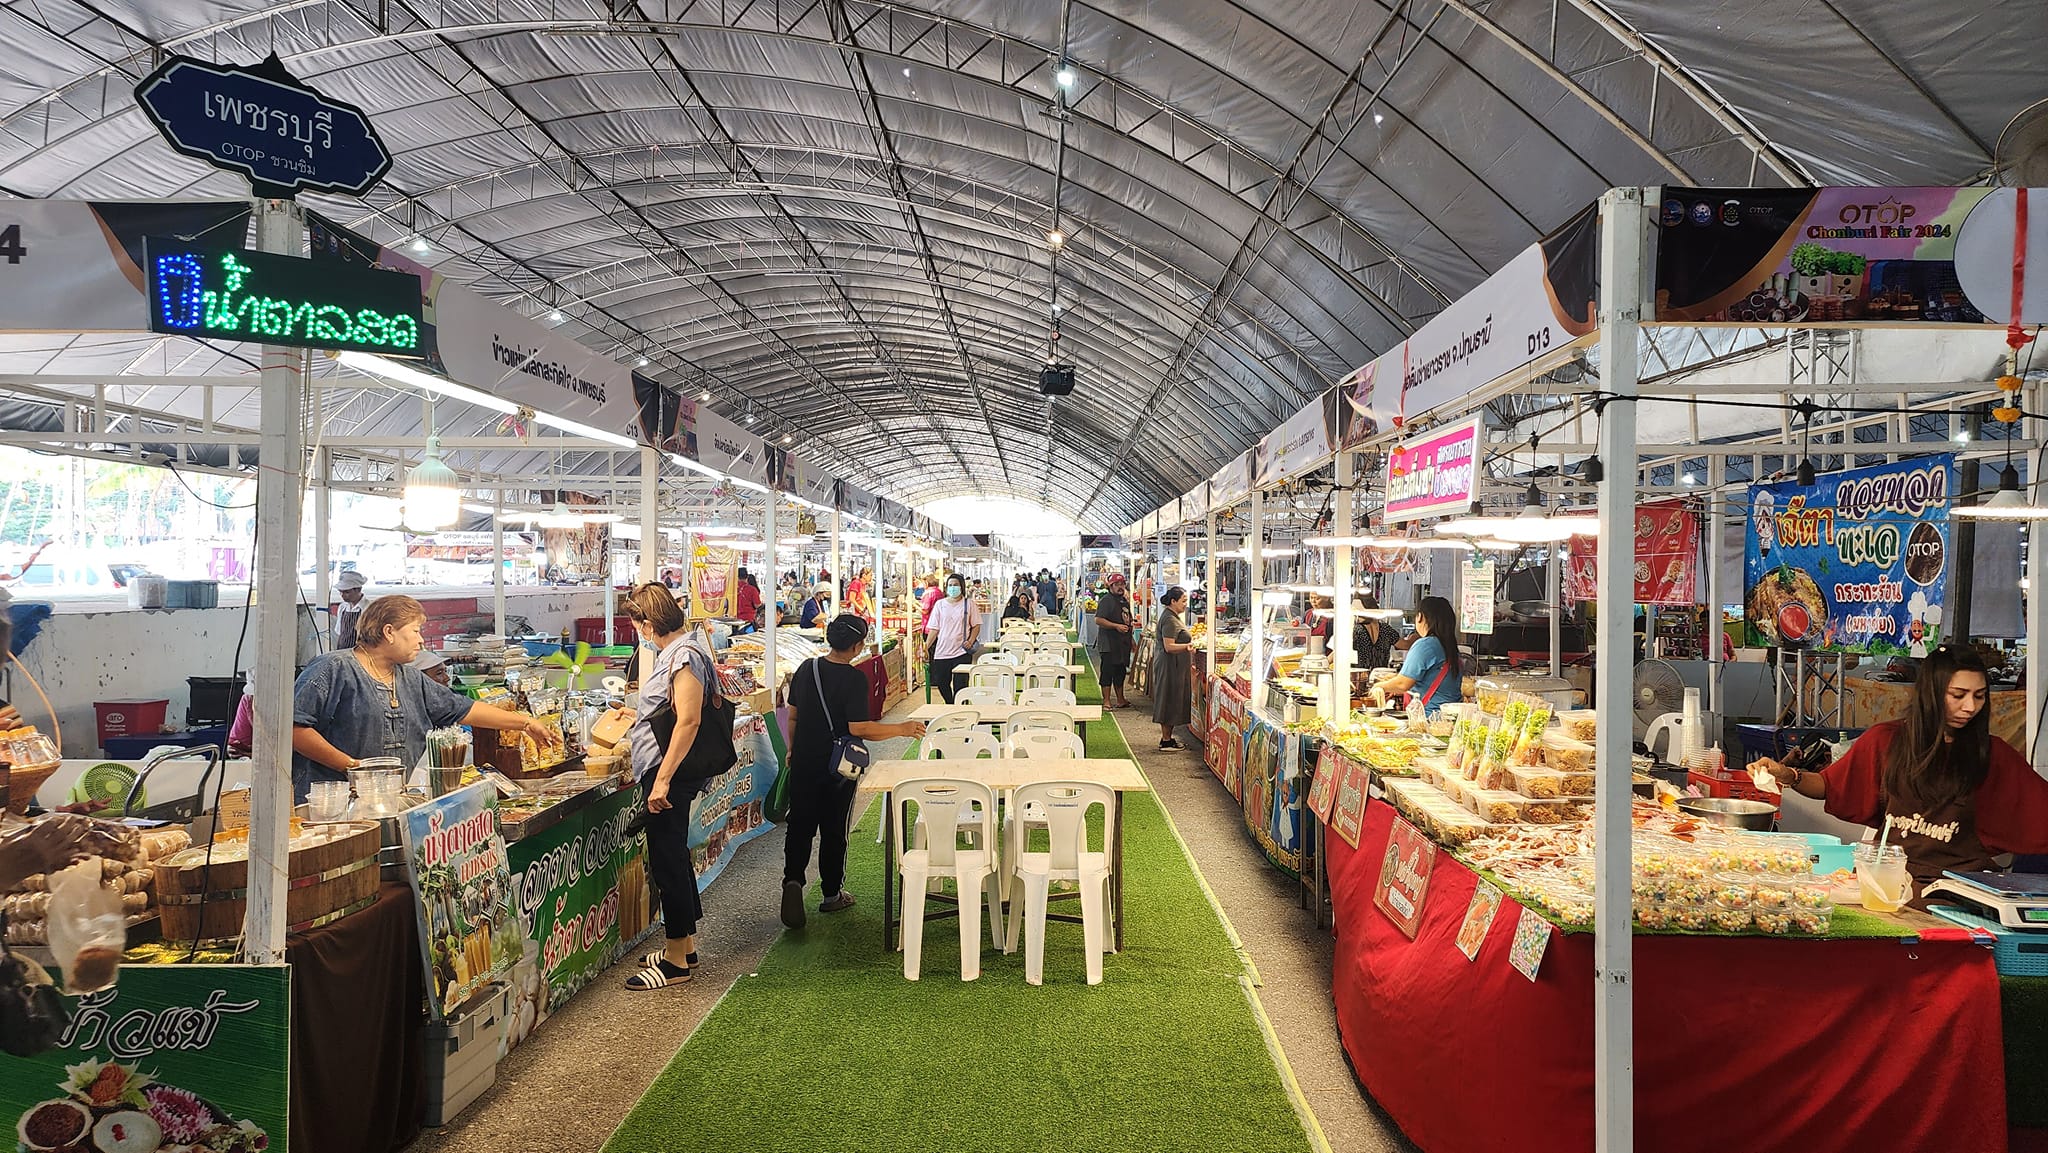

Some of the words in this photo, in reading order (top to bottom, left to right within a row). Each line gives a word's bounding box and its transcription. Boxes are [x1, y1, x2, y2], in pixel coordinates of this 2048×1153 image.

[204, 90, 334, 158] เพชรบุรี
[221, 142, 265, 162] OTOP
[270, 155, 316, 176] ชวนชิม
[1749, 206, 1773, 214] OTOP
[1839, 203, 1916, 224] OTOP
[1807, 224, 1877, 239] Chonburi
[1880, 224, 1912, 238] Fair
[1914, 224, 1952, 238] 2024
[202, 253, 417, 349] น้ำตาลสด
[1528, 326, 1550, 355] D13
[626, 423, 639, 438] C13
[1837, 466, 1947, 521] หอยทอด
[1775, 496, 1834, 547] เจ๊ตา
[1837, 525, 1900, 569] ทะเล
[1908, 542, 1940, 557] OTOP
[1834, 575, 1903, 602] กระทะร้อน
[424, 808, 496, 868] น้ำตาลสด
